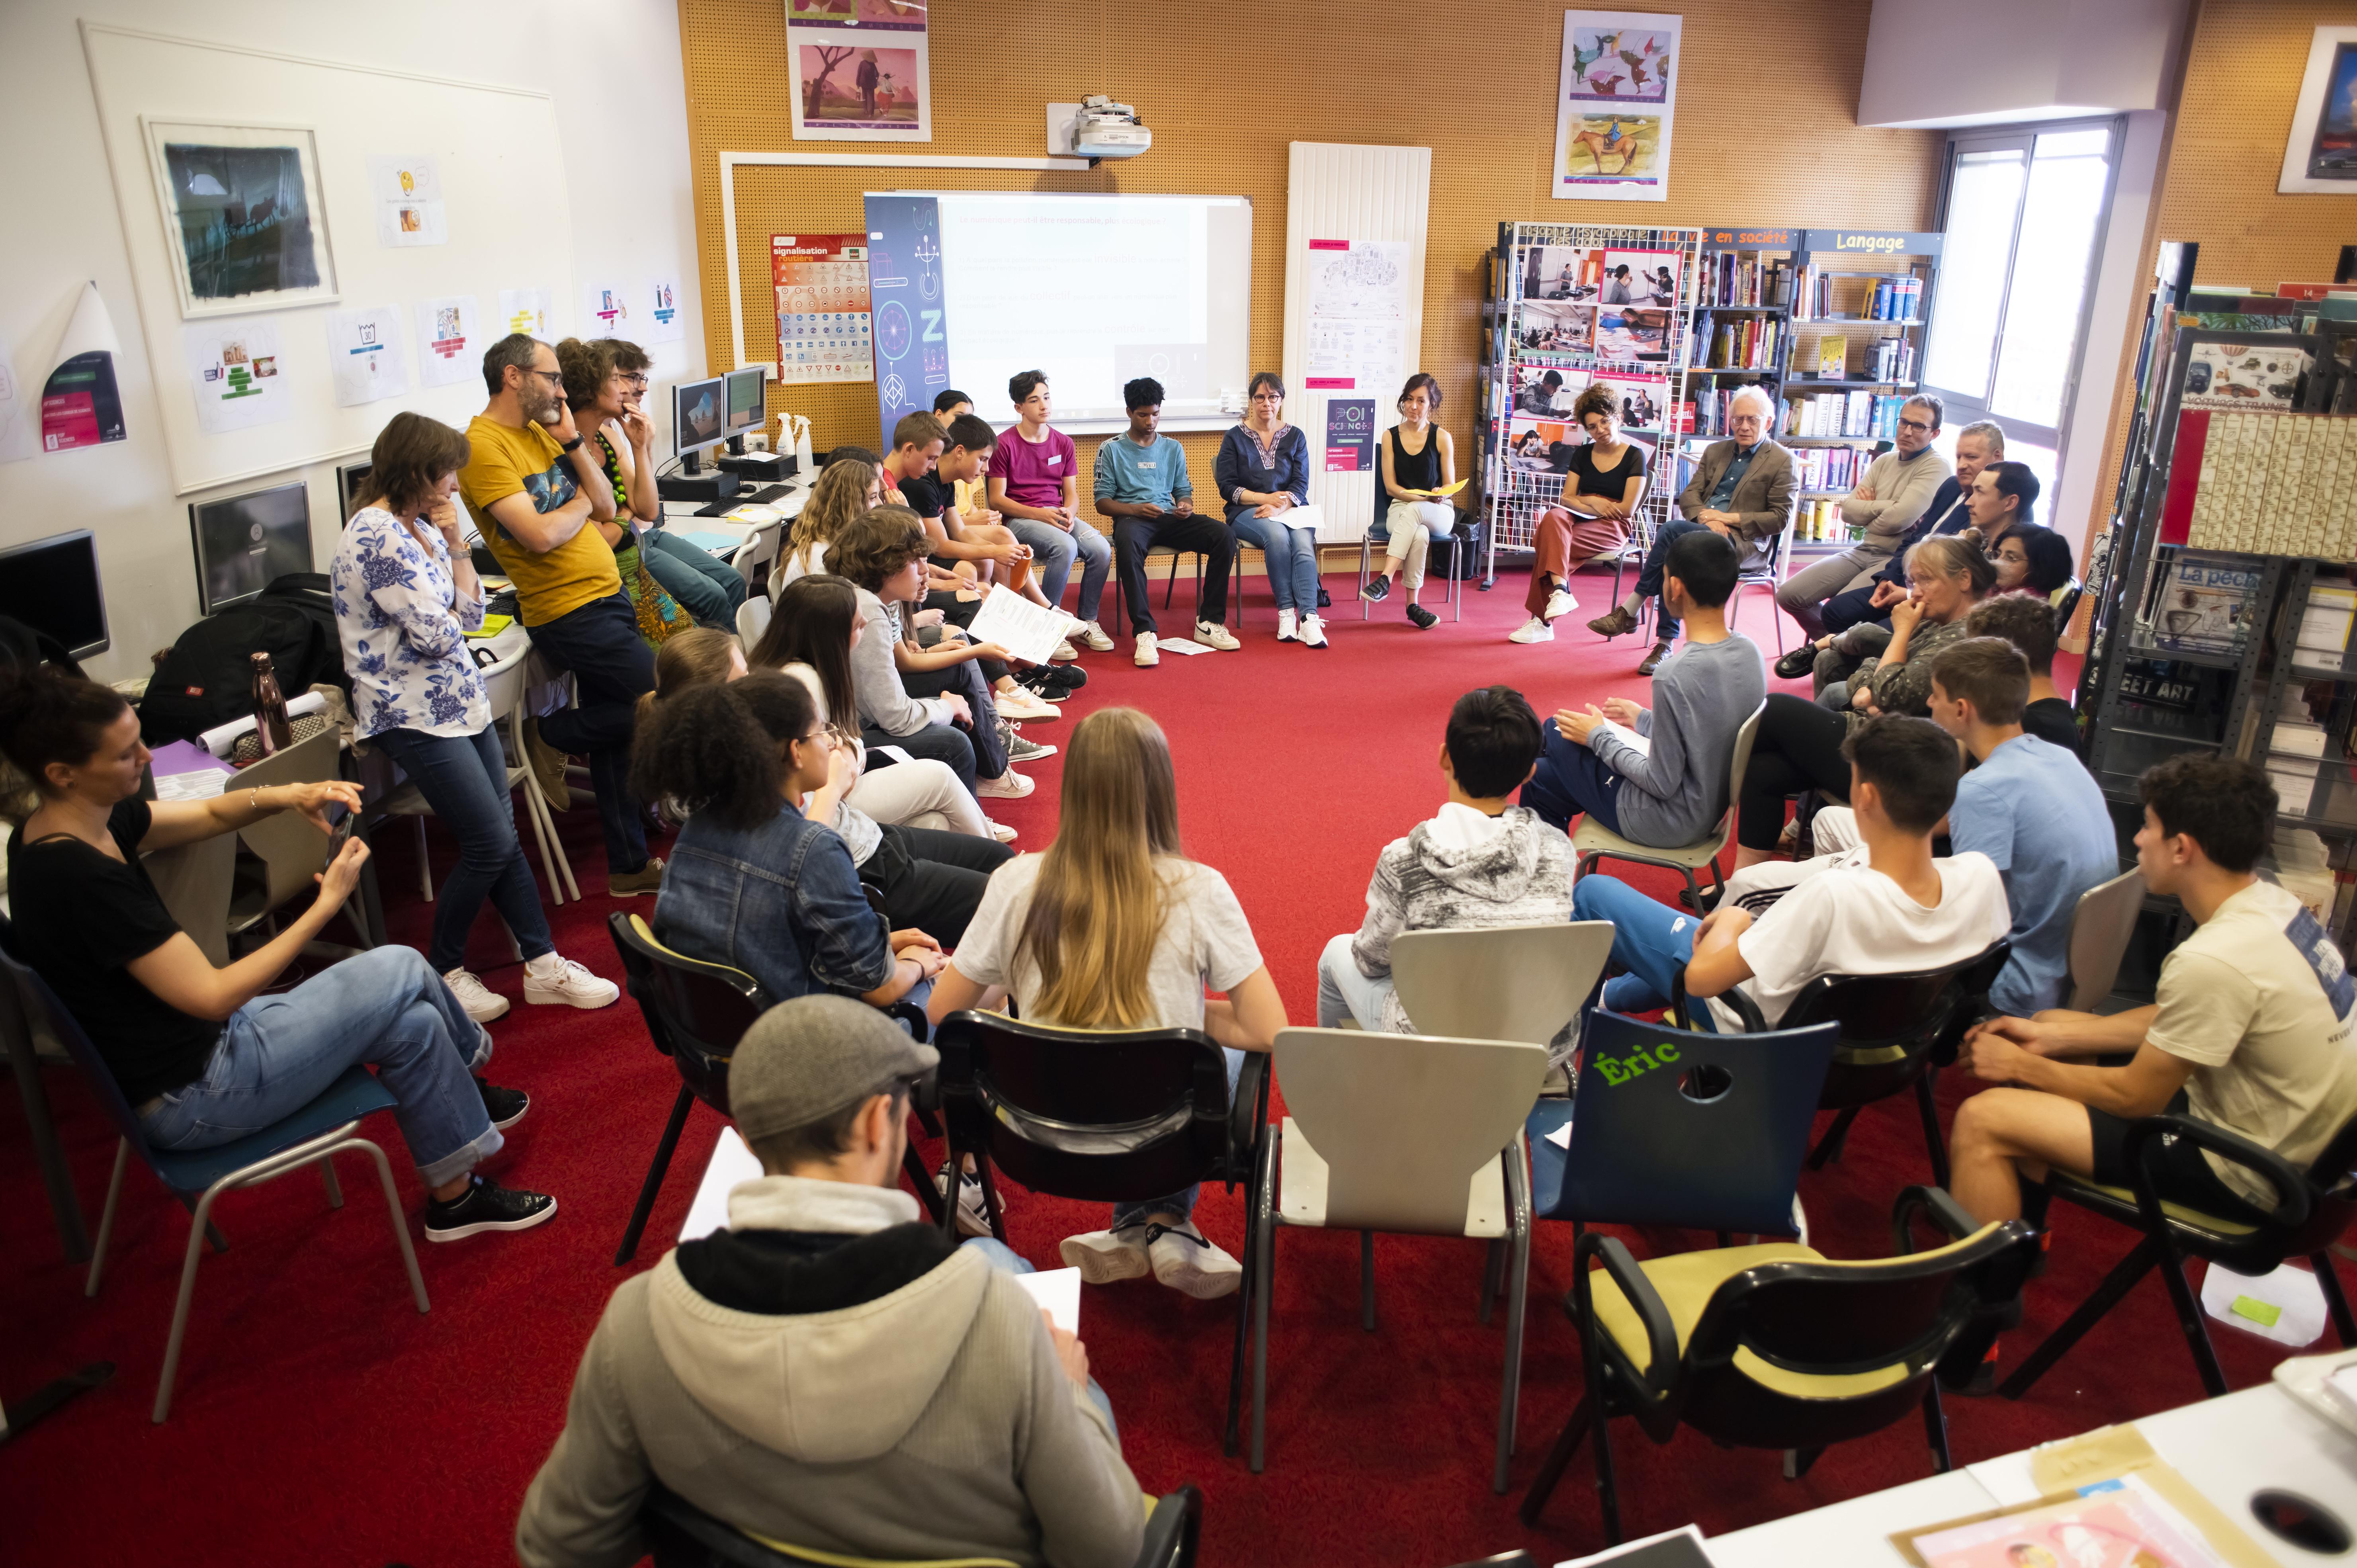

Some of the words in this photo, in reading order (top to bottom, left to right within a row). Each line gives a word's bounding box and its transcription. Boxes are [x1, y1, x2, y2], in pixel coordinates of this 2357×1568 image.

[971, 215, 1011, 225] numérique
[1013, 215, 1038, 225] peut-il
[1040, 215, 1055, 224] être
[1056, 216, 1104, 226] responsable,
[1105, 217, 1120, 226] plus
[1121, 217, 1161, 226] écologique
[1662, 230, 1678, 241] La
[1716, 232, 1733, 244] en
[1739, 229, 1788, 244] société
[1836, 233, 1904, 254] Langage
[773, 247, 828, 256] signalisation
[1093, 252, 1136, 263] invisible
[1030, 290, 1071, 301] collectif
[1104, 323, 1146, 334] contrôle
[365, 331, 371, 340] 30
[1819, 401, 1829, 434] ROBERT
[1834, 401, 1843, 434] ROBERT
[2179, 564, 2203, 583] La
[2156, 682, 2194, 701] ART
[1593, 1043, 1681, 1087] Éric
